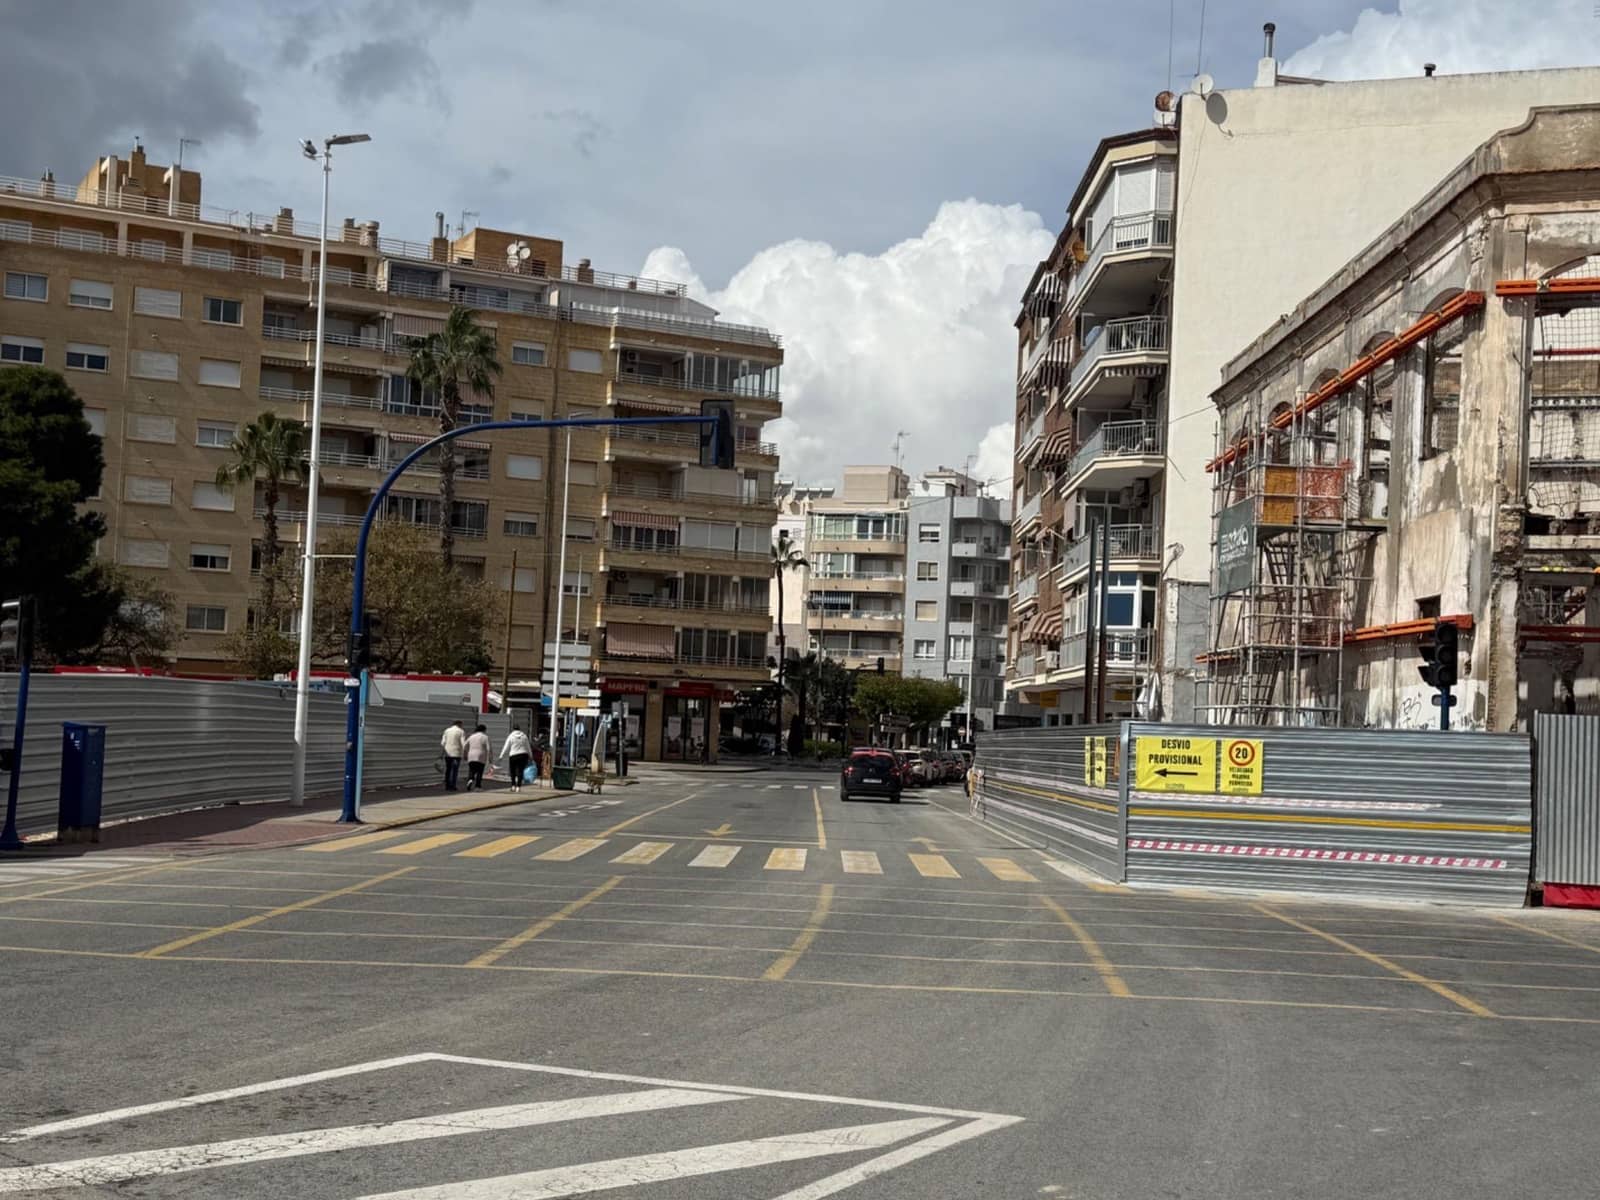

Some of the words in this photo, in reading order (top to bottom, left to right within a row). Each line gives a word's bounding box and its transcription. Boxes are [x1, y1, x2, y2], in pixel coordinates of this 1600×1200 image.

[1161, 739, 1191, 750] DESVIO
[1235, 747, 1248, 759] 20
[1148, 754, 1203, 766] PROVISIONAL
